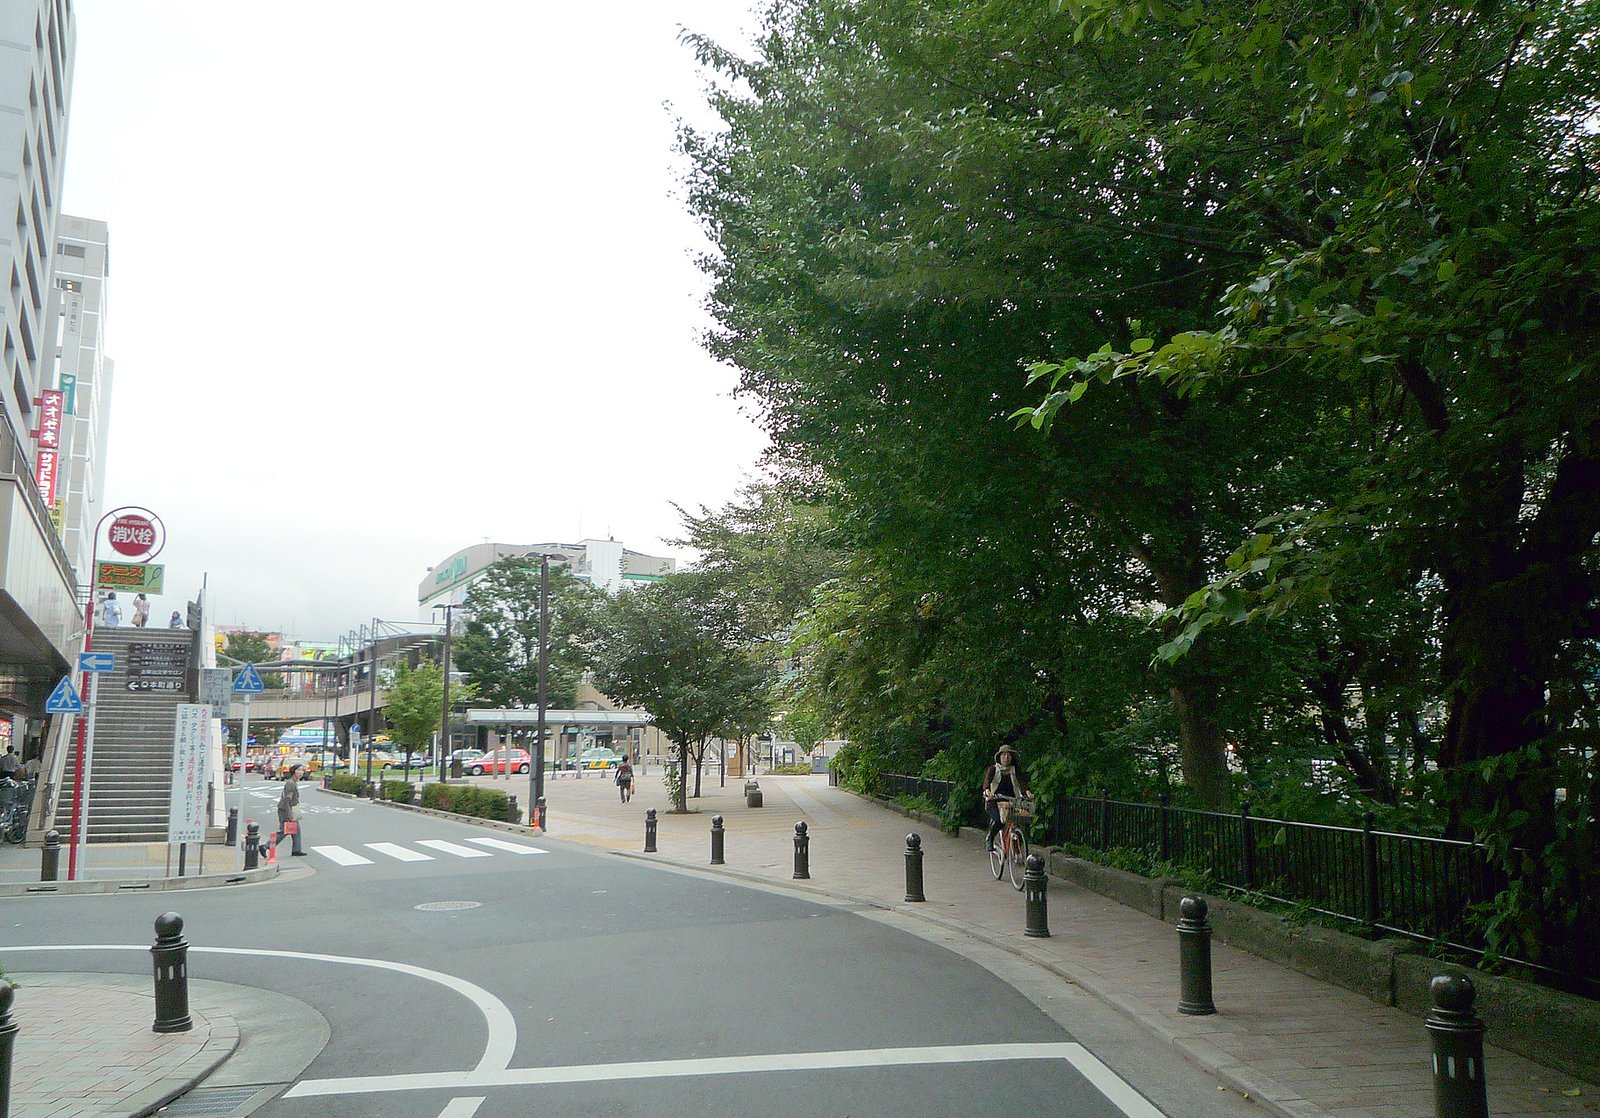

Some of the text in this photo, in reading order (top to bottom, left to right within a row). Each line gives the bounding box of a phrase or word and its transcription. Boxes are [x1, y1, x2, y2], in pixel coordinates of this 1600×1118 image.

[112, 526, 153, 545] 消火栓
[101, 564, 144, 577] テニス
